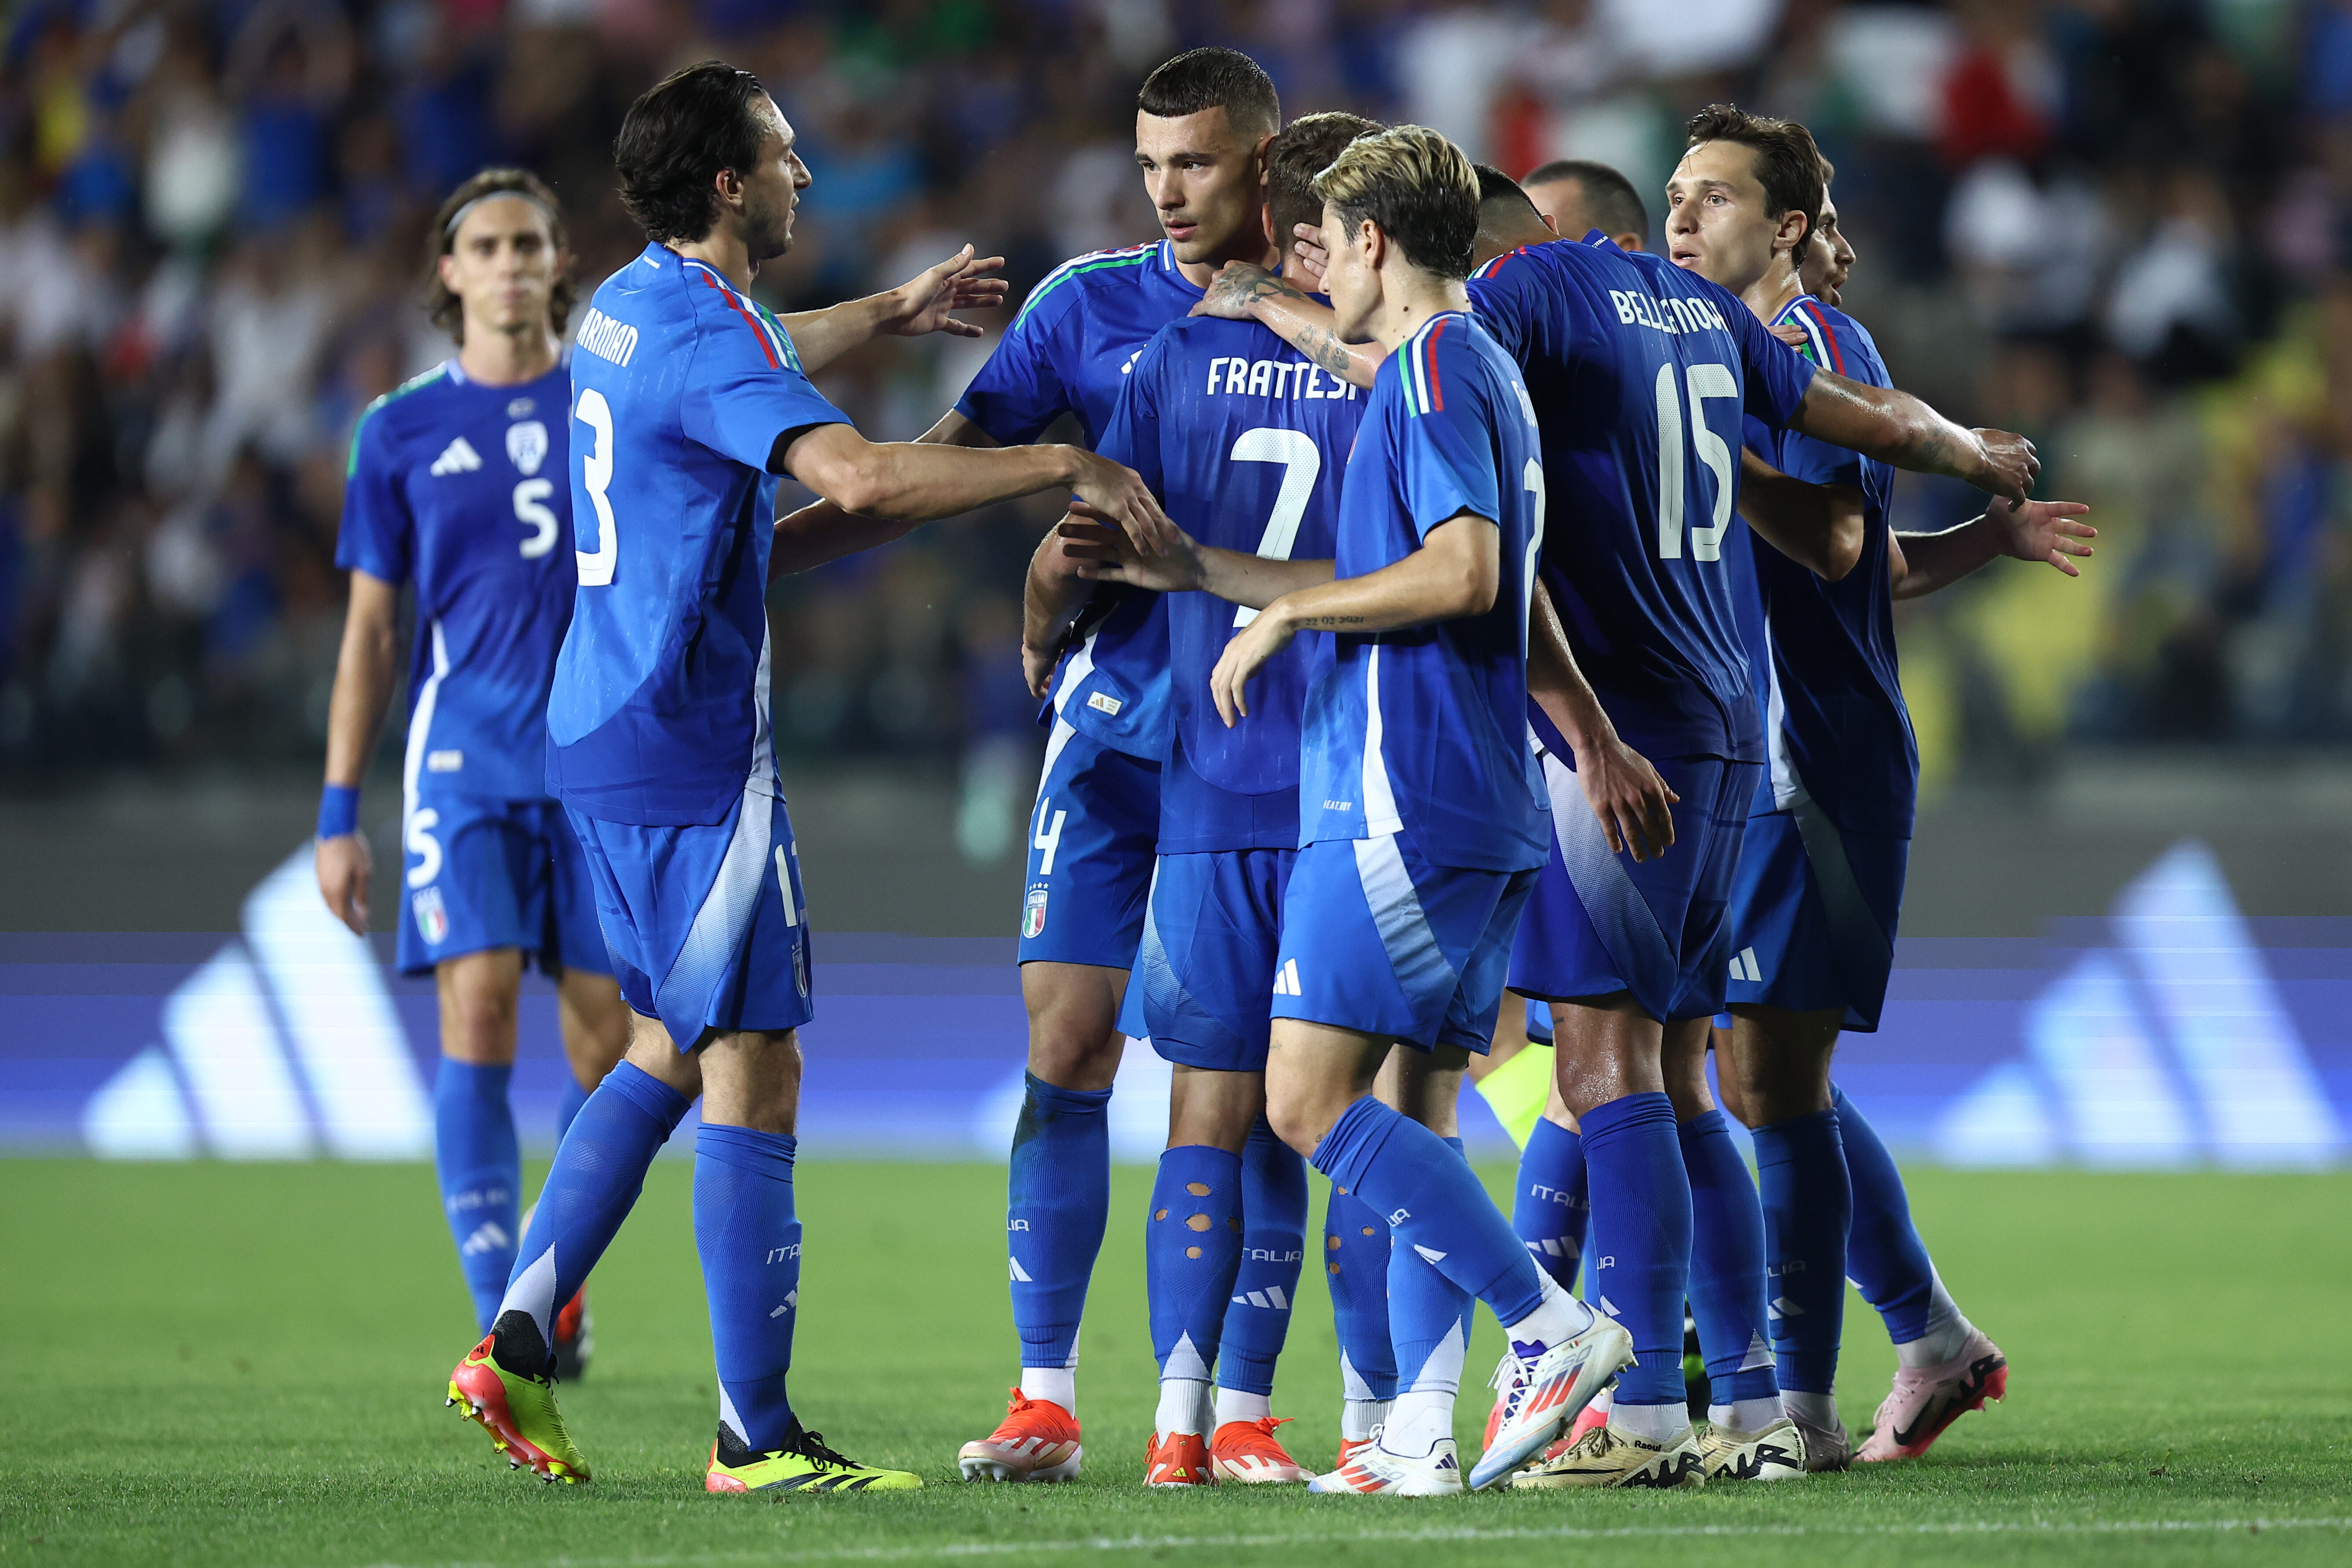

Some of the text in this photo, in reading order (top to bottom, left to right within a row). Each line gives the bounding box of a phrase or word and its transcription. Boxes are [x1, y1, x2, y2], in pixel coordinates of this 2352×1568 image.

[1656, 363, 1738, 561] 15
[512, 477, 559, 560] 5
[1230, 428, 1320, 627] 7
[407, 807, 442, 889] 5
[1034, 796, 1067, 875] 4
[1028, 894, 1044, 905] ITALIA
[1543, 1345, 1593, 1380] F50
[1366, 1460, 1406, 1480] F50
[1634, 1440, 1662, 1452] Raoul
